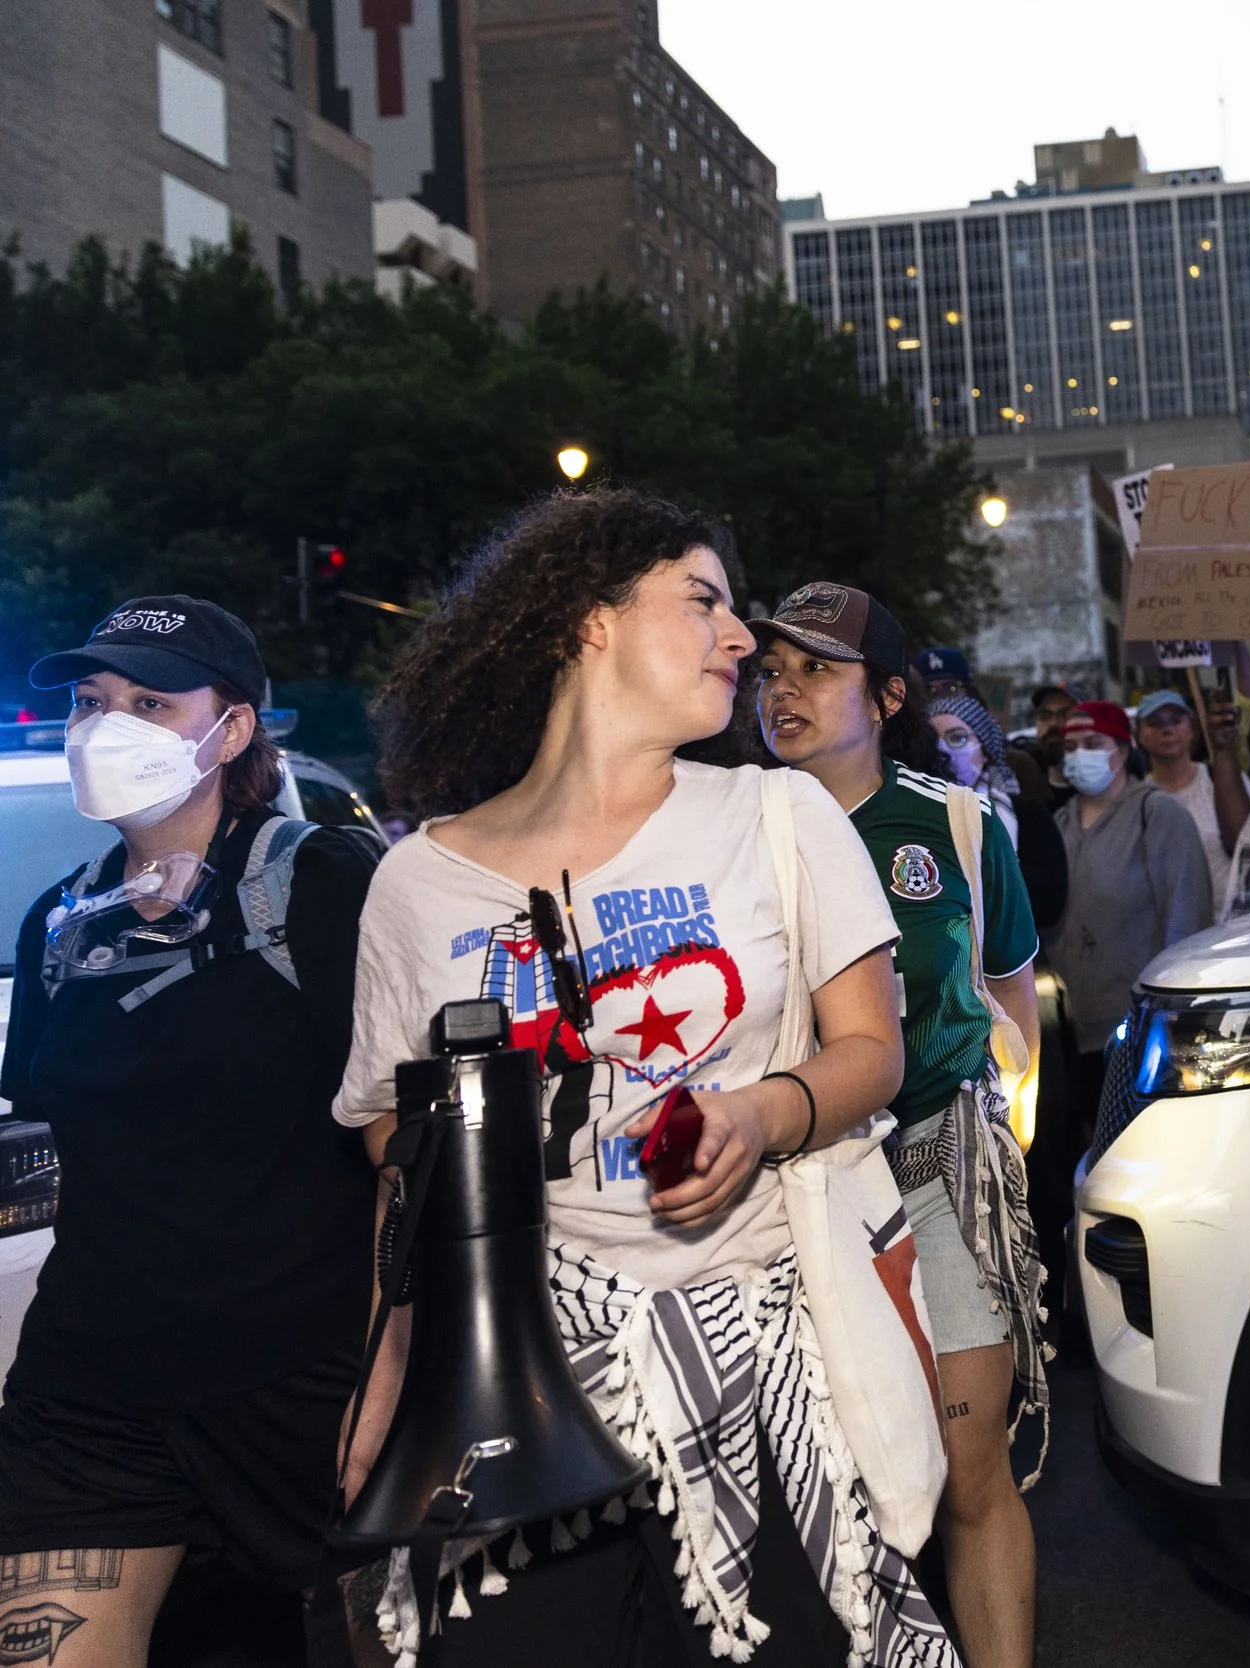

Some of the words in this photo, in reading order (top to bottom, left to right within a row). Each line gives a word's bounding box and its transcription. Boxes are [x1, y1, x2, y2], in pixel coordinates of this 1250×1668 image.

[1151, 476, 1250, 532] FUCK
[1140, 556, 1198, 589] FROM
[97, 614, 185, 634] NOW
[143, 760, 168, 772] KN95
[592, 886, 689, 938] BREAD
[575, 913, 721, 984] EIGHBORS
